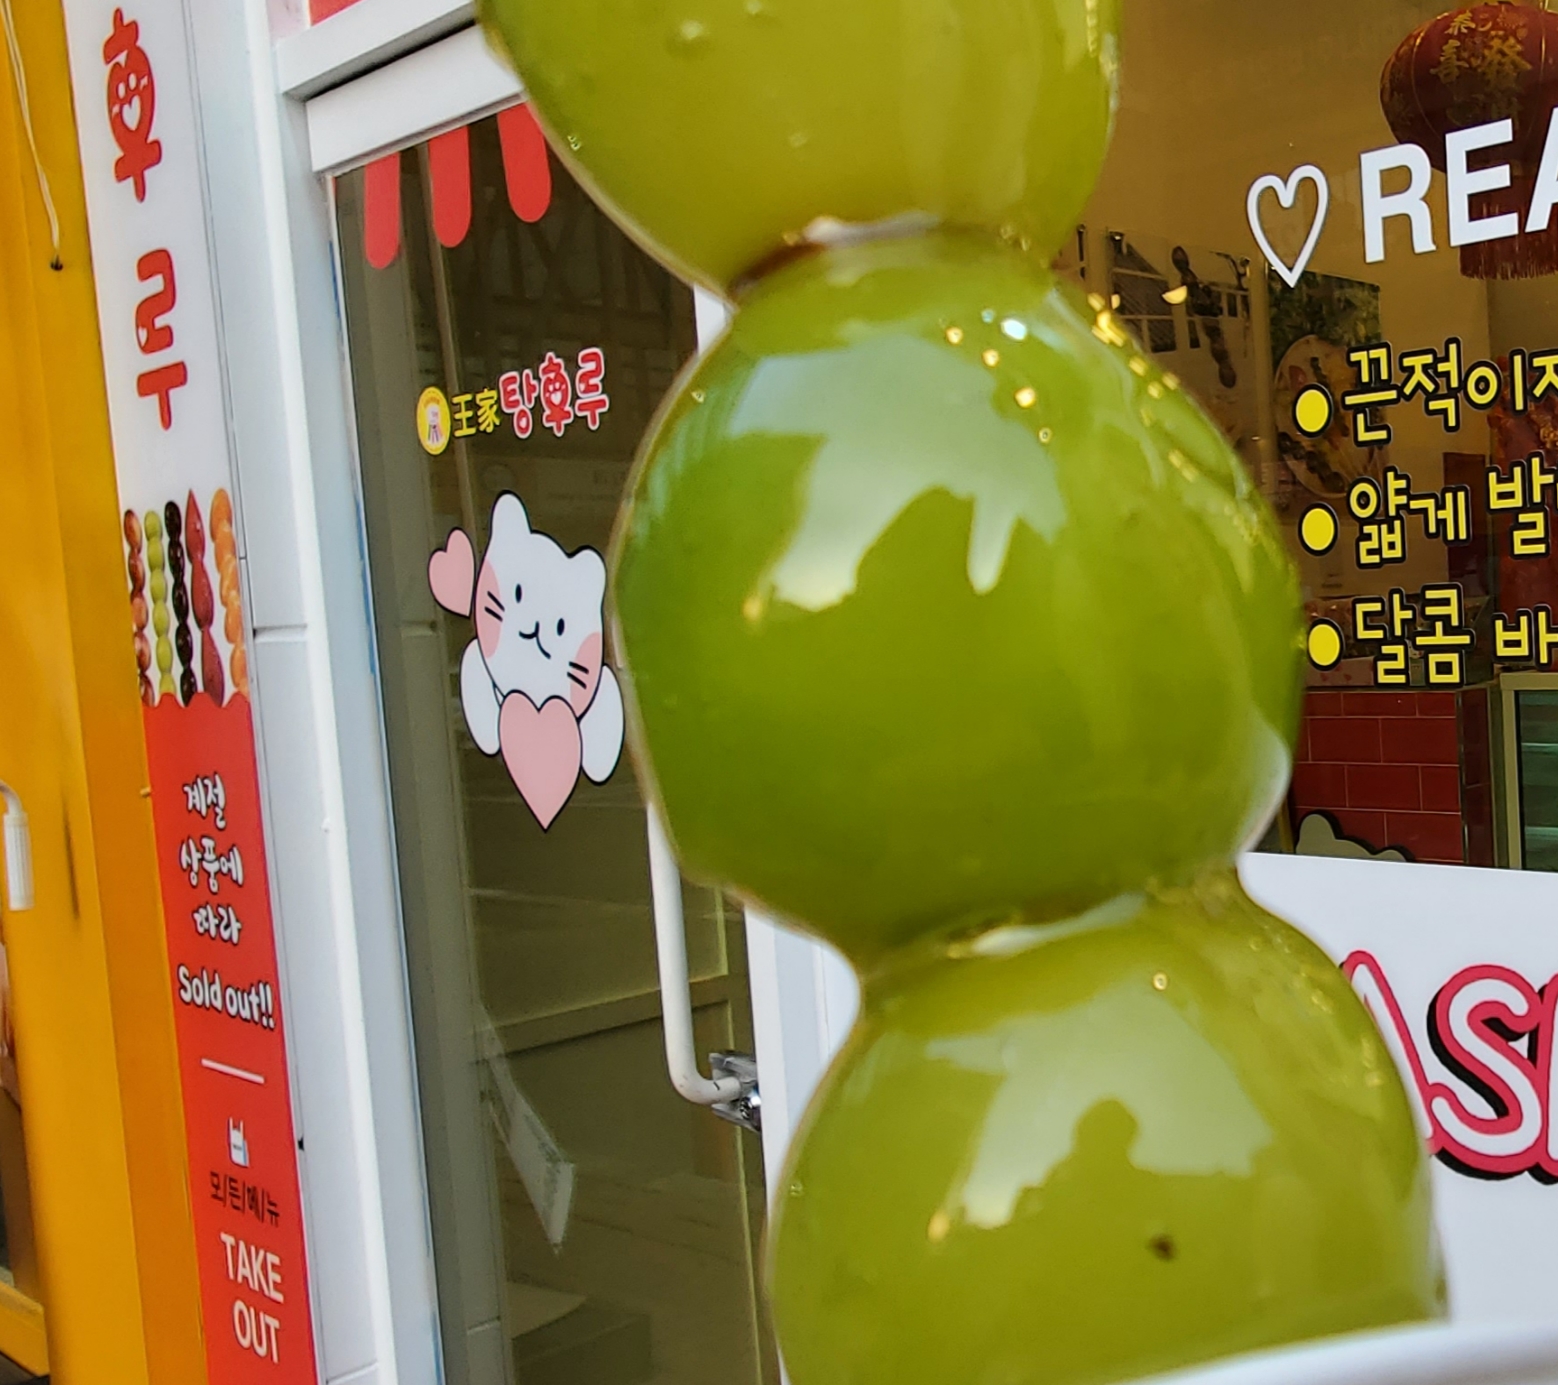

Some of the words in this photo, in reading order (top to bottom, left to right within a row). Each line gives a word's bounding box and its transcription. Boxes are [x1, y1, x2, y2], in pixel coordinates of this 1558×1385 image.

[452, 388, 500, 437] 王家
[499, 347, 609, 439] 탕후루
[1347, 468, 1468, 566] 얇게
[1353, 586, 1473, 686] 달콤
[183, 772, 227, 830] 계절
[179, 835, 244, 894] 상품에
[178, 964, 222, 1013] Sold
[225, 981, 276, 1030] out!!
[220, 1231, 284, 1304] TAKE
[233, 1299, 280, 1364] OUT
